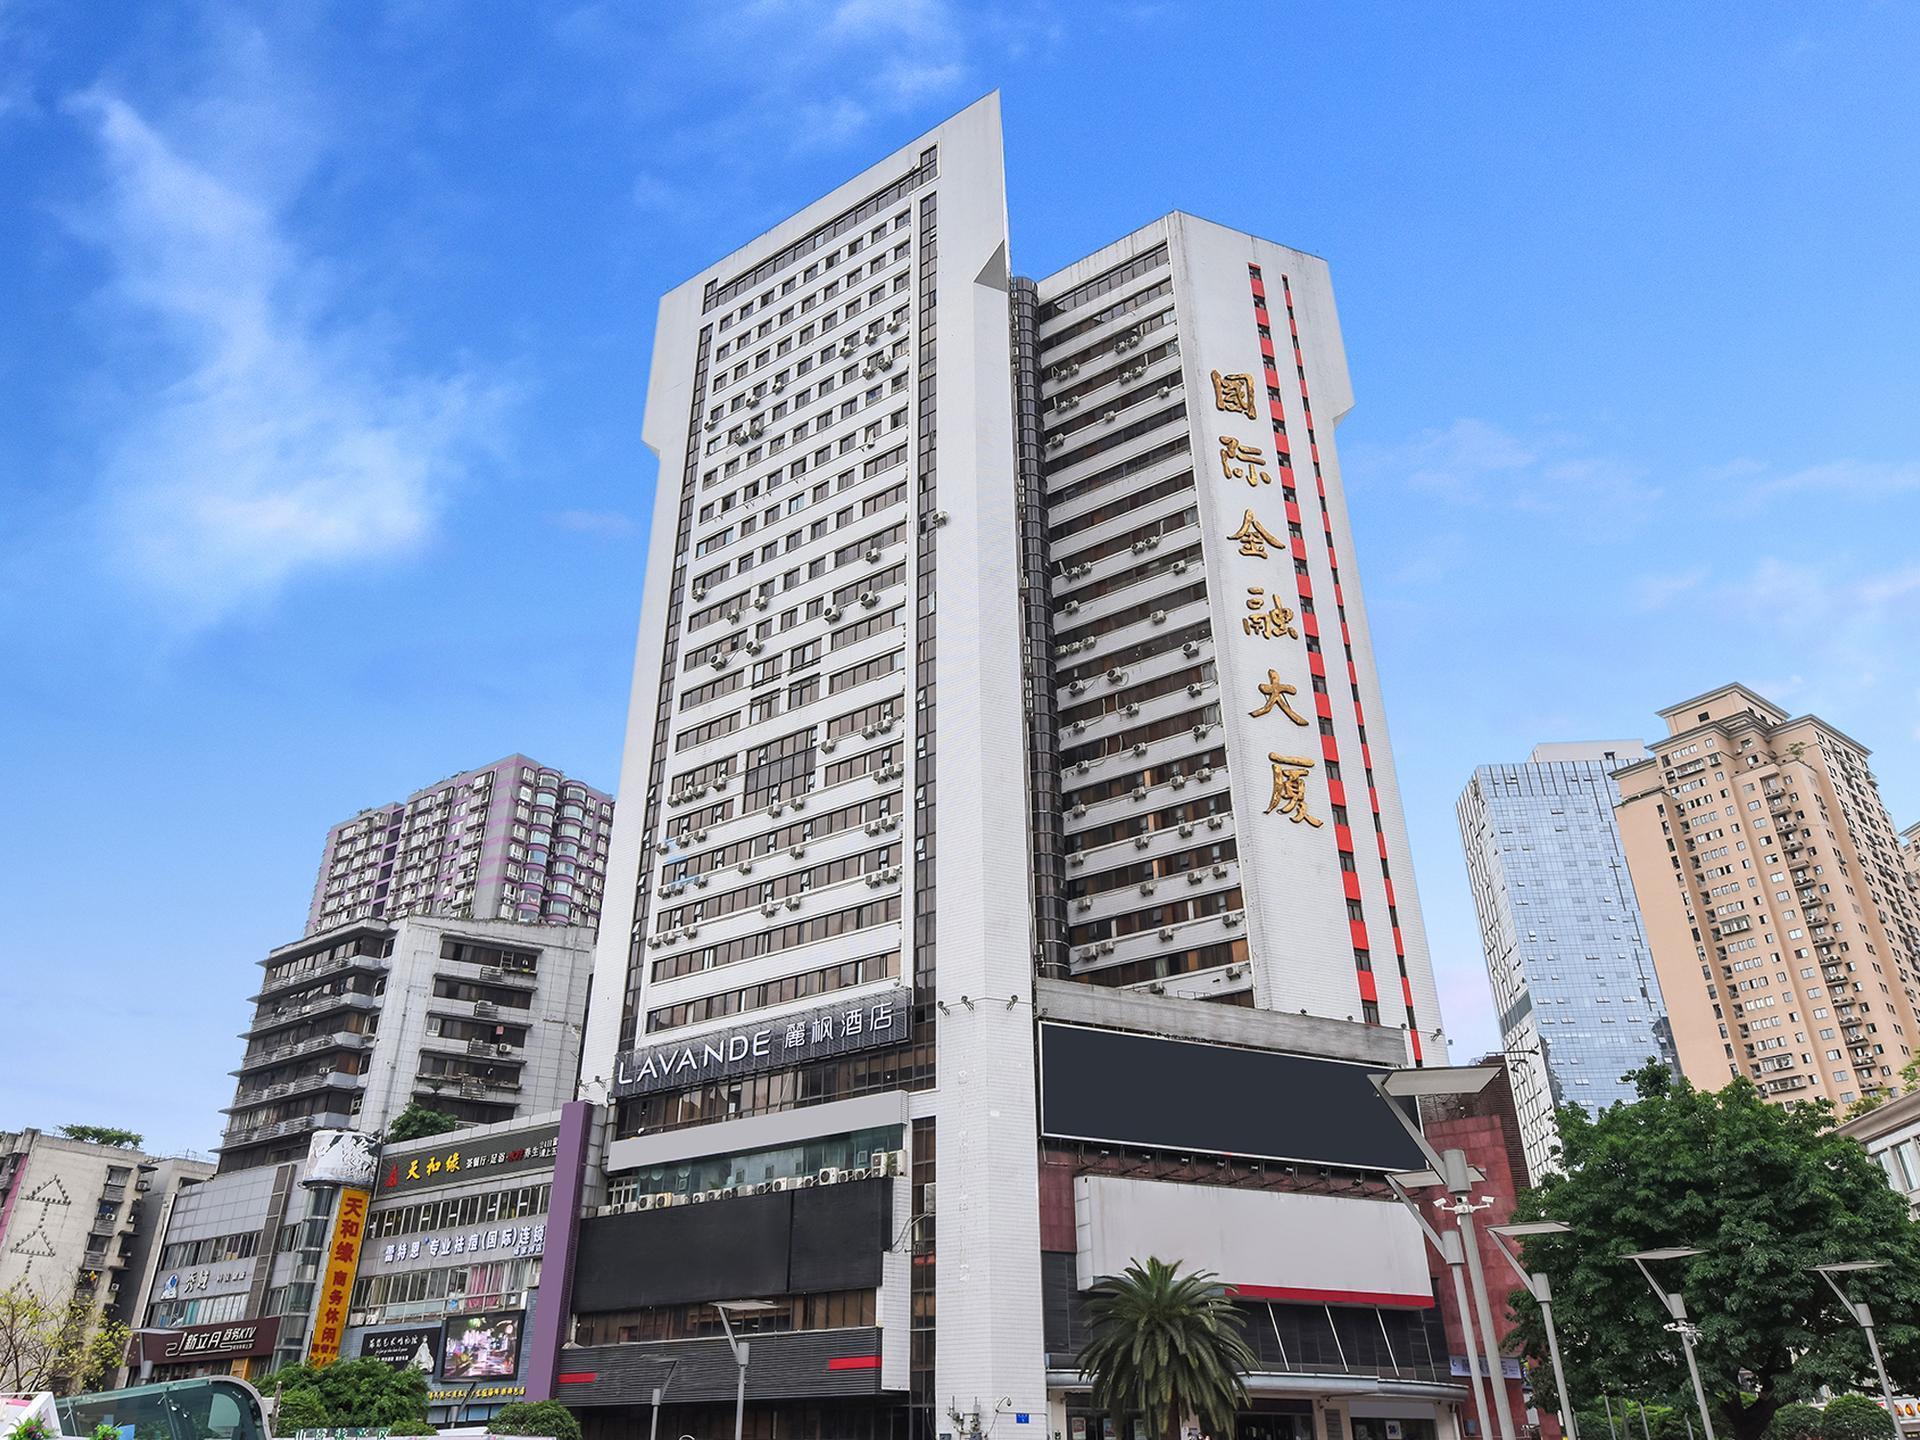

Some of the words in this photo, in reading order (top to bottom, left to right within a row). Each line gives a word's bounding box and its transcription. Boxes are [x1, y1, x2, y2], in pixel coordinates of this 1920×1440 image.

[617, 1028, 771, 1085] LAVANDE
[784, 1001, 894, 1049] 麗枫酒店
[405, 1151, 462, 1181] 天和缘
[334, 1197, 363, 1263] 天和缘
[321, 1270, 348, 1344] 商务休闲
